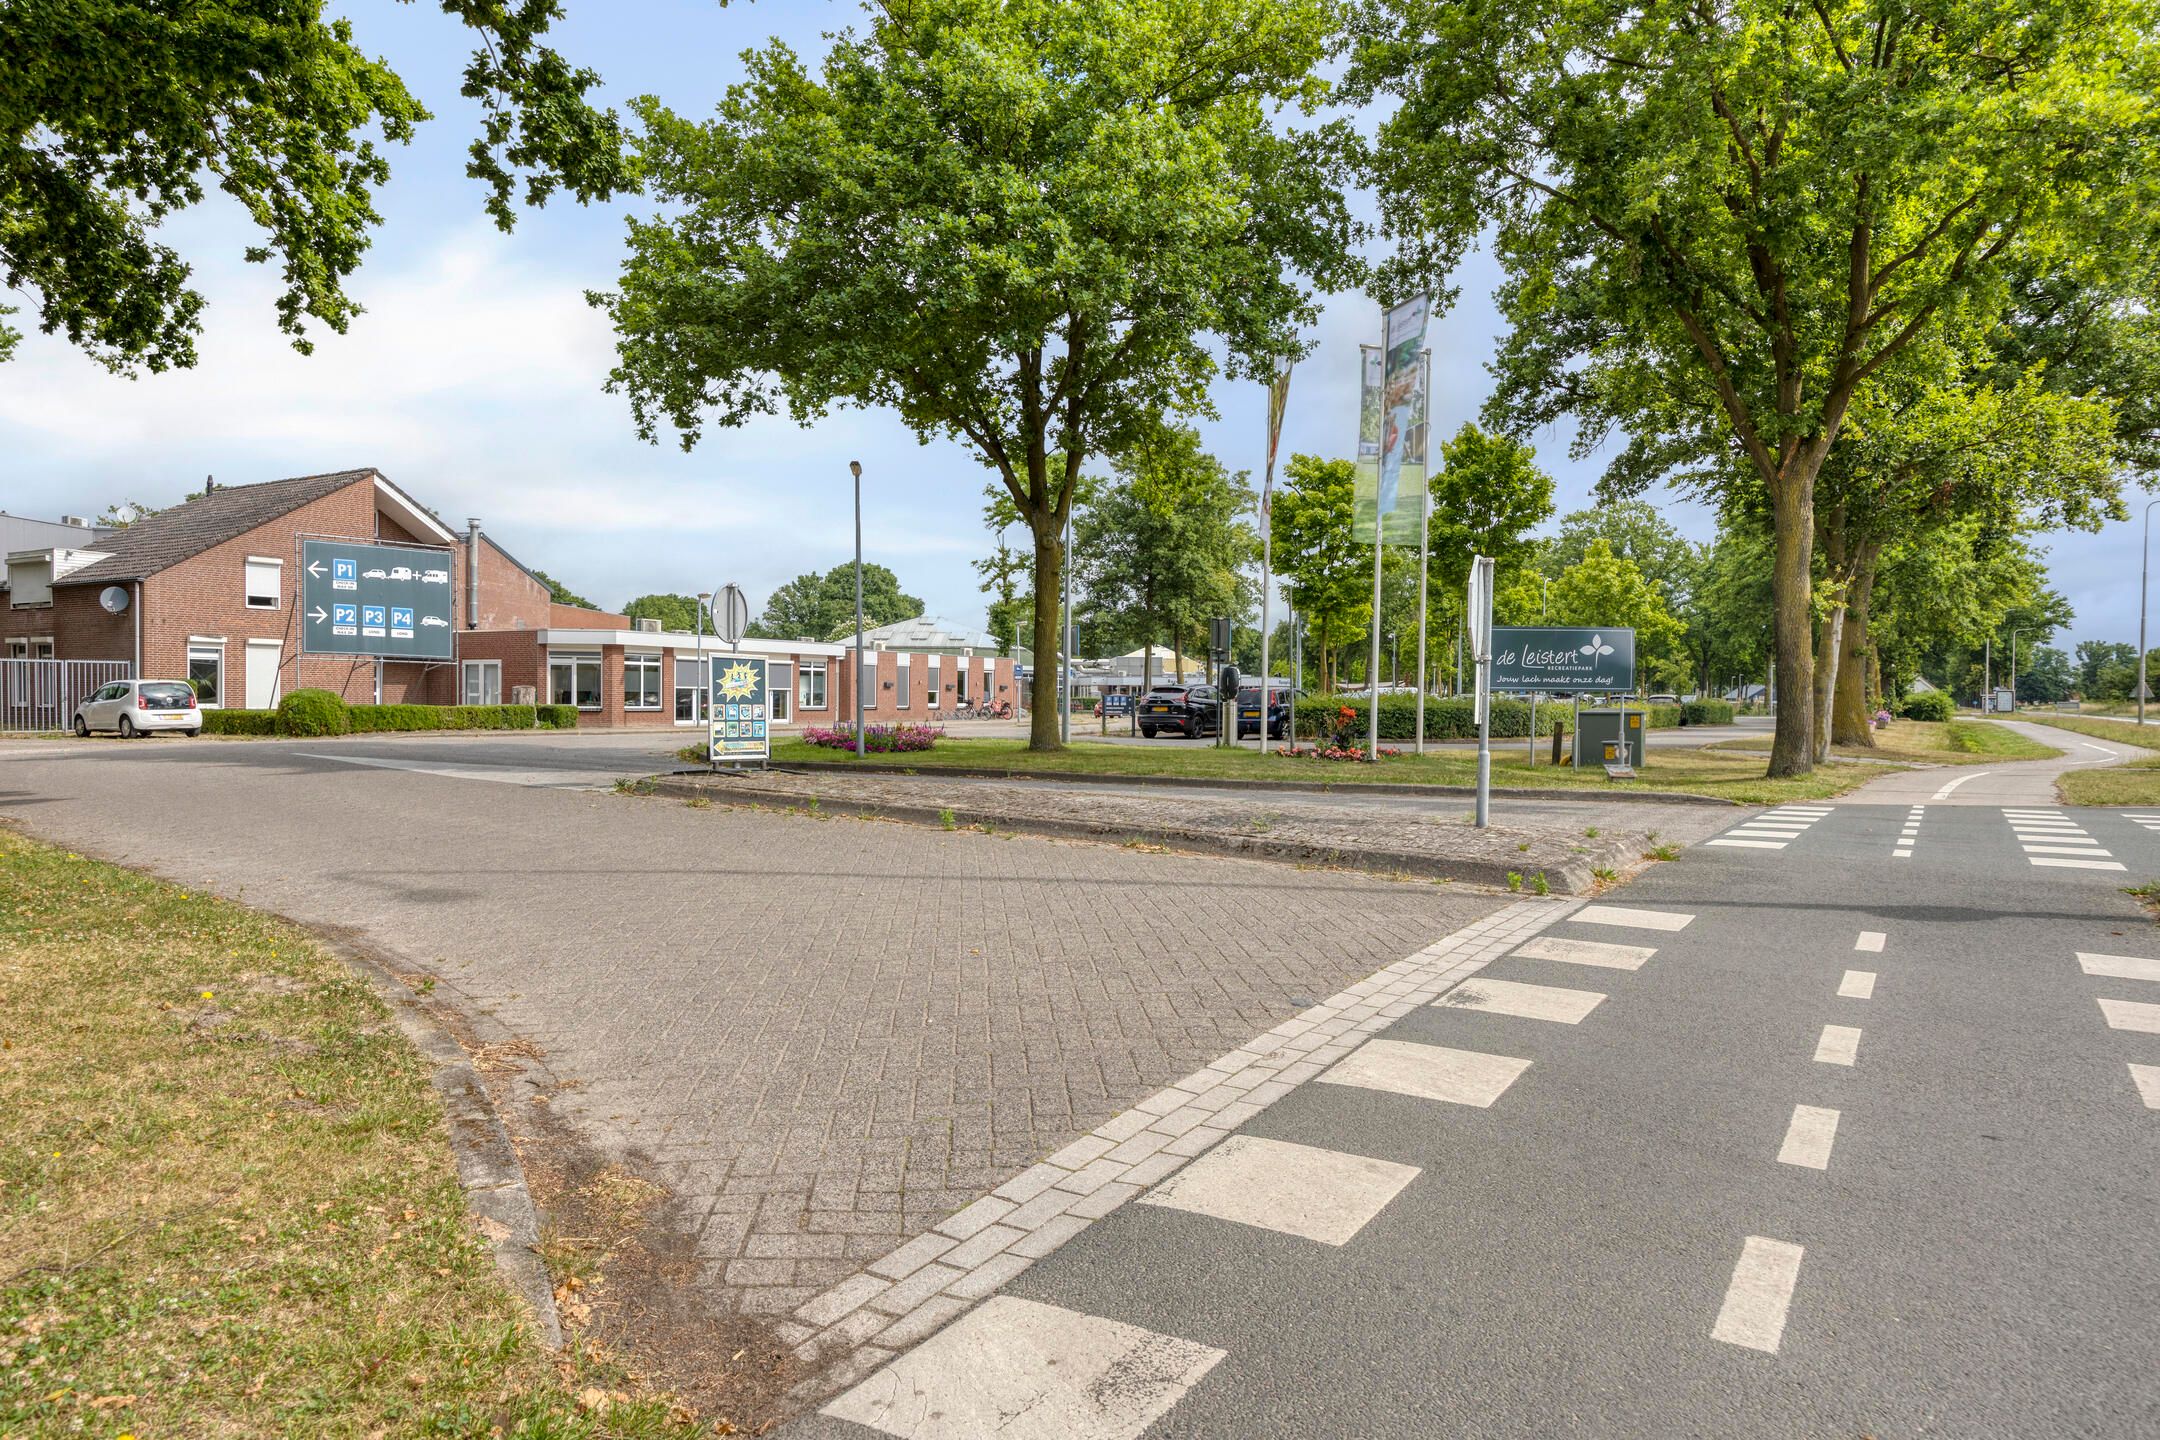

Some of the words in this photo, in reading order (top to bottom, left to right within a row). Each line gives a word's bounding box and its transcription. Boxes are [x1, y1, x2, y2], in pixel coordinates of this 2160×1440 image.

[337, 563, 353, 577] P1
[336, 608, 355, 622] P2
[365, 610, 383, 623] P3
[393, 612, 411, 625] P4
[1496, 649, 1516, 665] de
[1521, 643, 1579, 668] Leistert
[1496, 675, 1520, 683] Jouw
[1521, 675, 1541, 683] lach
[1594, 676, 1614, 685] dag!
